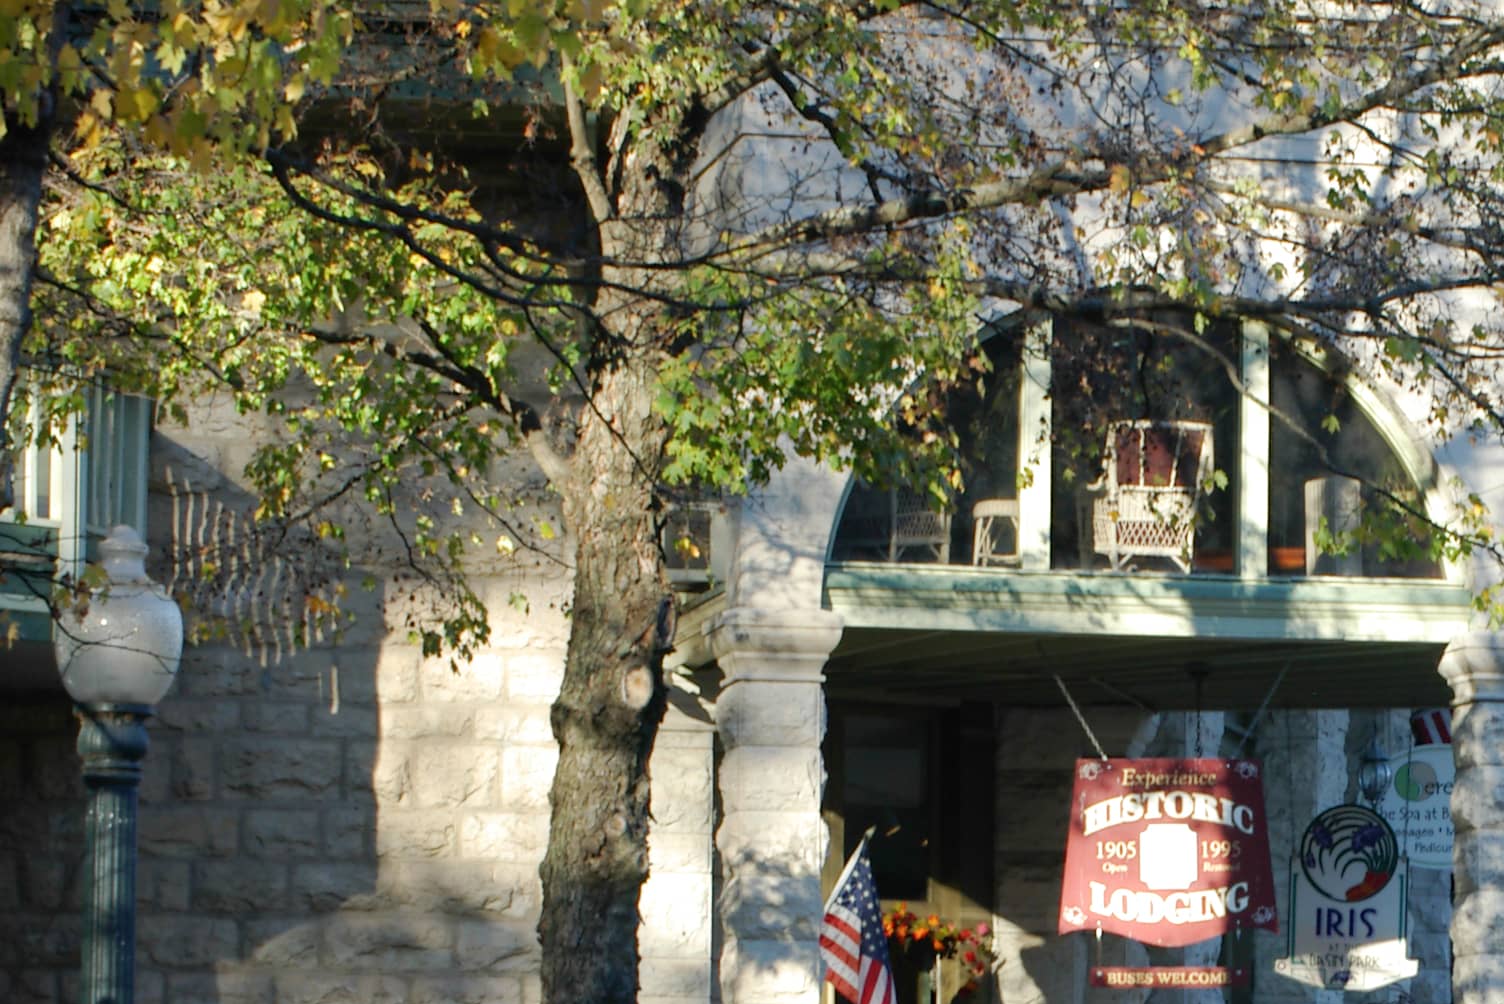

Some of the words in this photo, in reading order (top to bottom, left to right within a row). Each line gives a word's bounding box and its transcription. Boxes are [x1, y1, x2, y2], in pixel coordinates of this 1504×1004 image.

[1121, 767, 1217, 789] Experience
[1083, 790, 1254, 837] HISTORIC
[1400, 806, 1420, 822] Spa
[1425, 808, 1437, 821] at
[1096, 840, 1137, 860] 1905
[1201, 839, 1242, 859] 1995
[1102, 862, 1128, 873] Open
[1088, 880, 1250, 925] LODGING
[1315, 907, 1377, 938] IRIS
[1348, 955, 1381, 968] PARK
[1107, 973, 1154, 985] BUSES
[1157, 972, 1232, 985] WELCOME
